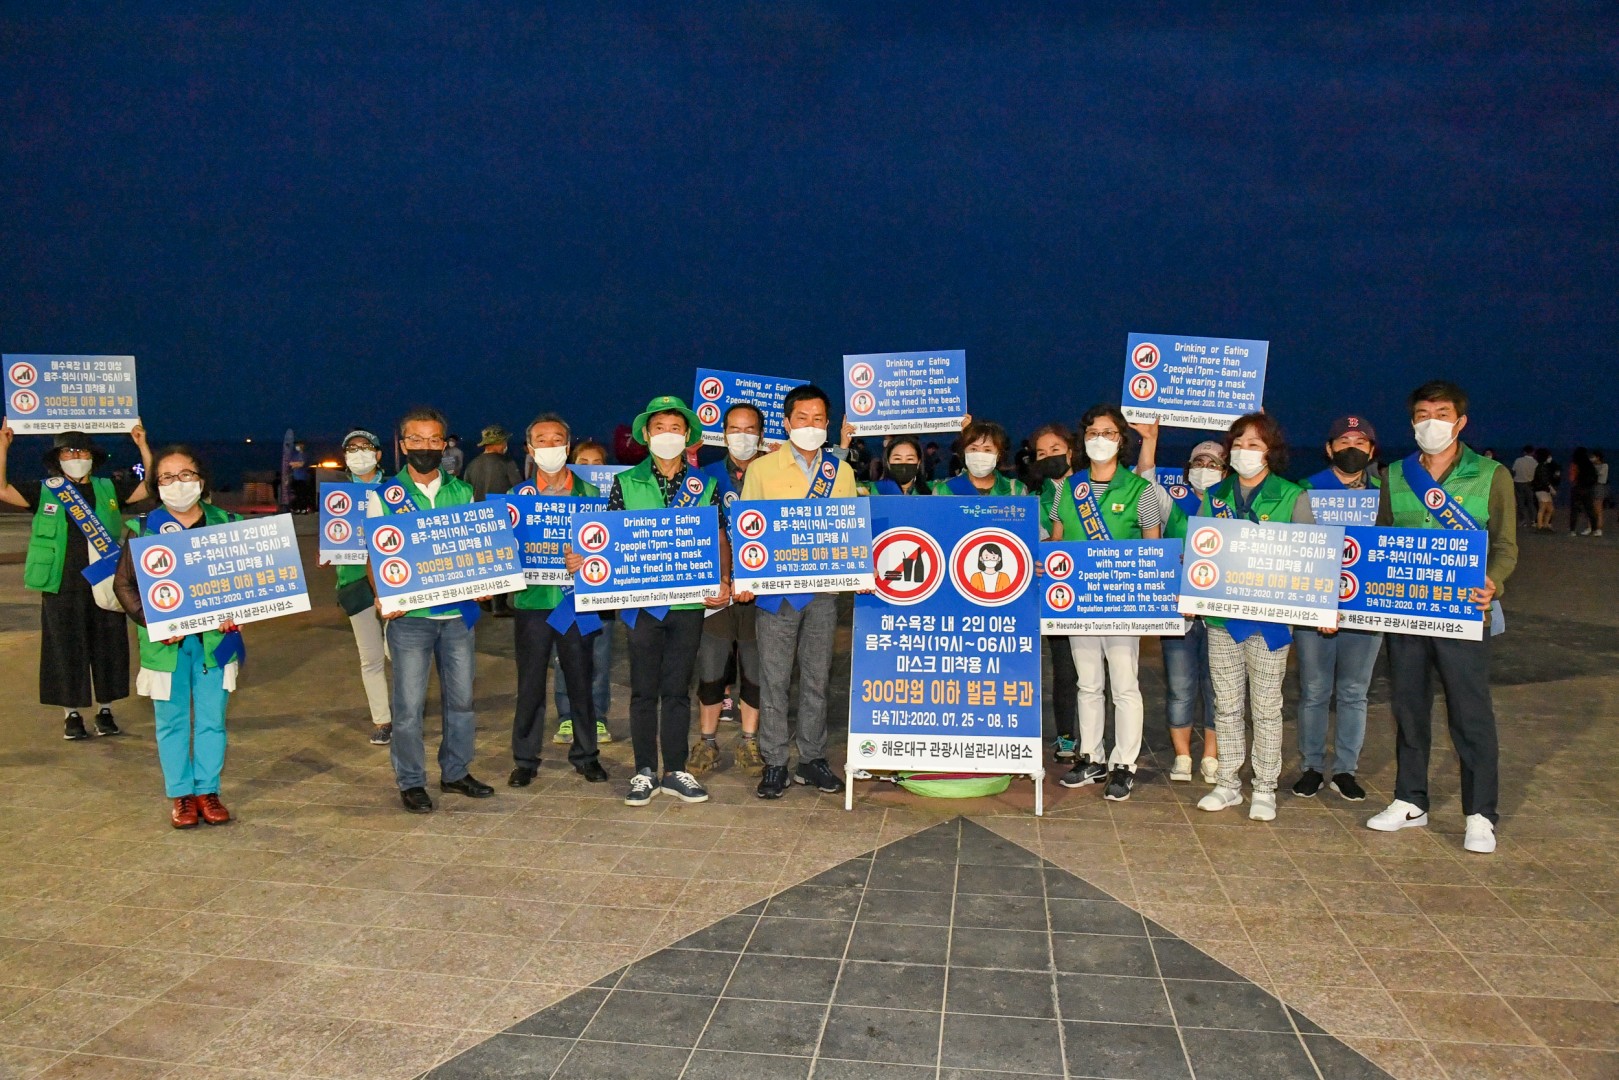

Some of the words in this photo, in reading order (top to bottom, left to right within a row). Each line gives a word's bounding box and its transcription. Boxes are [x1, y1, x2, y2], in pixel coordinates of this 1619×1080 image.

[1174, 342, 1206, 354] Drinking
[1224, 345, 1249, 357] Eating
[50, 361, 80, 370] 해수욕장
[83, 361, 90, 370] 내
[94, 361, 105, 370] 2인
[107, 361, 121, 370] 이상
[886, 358, 913, 368] Drinking
[929, 356, 949, 367] Eating
[61, 384, 82, 393] 마스크
[85, 384, 105, 393] 미착용
[108, 384, 114, 392] 시
[44, 396, 77, 406] 300만원
[80, 396, 95, 406] 이하
[99, 396, 114, 406] 벌금
[117, 396, 132, 406] 부과
[63, 421, 125, 429] 관광시설관리사업소
[780, 505, 811, 517] 해수욕장
[814, 505, 822, 516] 내
[826, 505, 838, 515] 2인
[840, 504, 855, 515] 이상
[1361, 497, 1375, 508] 2인
[416, 514, 449, 529] 해수욕장
[451, 512, 460, 523] 내
[463, 509, 477, 522] 2인
[477, 507, 494, 519] 이상
[623, 516, 656, 528] Drinking
[661, 517, 669, 525] or
[675, 514, 700, 526] Eating
[190, 531, 227, 549] 해수욕장
[229, 529, 240, 542] 내
[242, 526, 258, 540] 2인
[259, 523, 278, 537] 이상
[632, 529, 649, 538] with
[652, 529, 672, 537] more
[675, 526, 692, 535] than
[791, 533, 813, 544] 마스크
[816, 532, 838, 543] 미착용
[841, 532, 848, 542] 시
[1240, 527, 1275, 540] 해수욕장
[1278, 529, 1287, 541] 내
[1291, 530, 1306, 542] 2인
[1308, 531, 1327, 544] 이상
[432, 541, 456, 555] 마스크
[457, 536, 482, 551] 미착용
[483, 535, 491, 546] 시
[1378, 535, 1413, 548] 해수욕장
[1417, 536, 1426, 548] 내
[1431, 537, 1446, 550] 2인
[1449, 538, 1468, 551] 이상
[624, 552, 636, 562] Not
[640, 551, 671, 562] wearing
[681, 549, 702, 558] mask
[773, 548, 808, 562] 300만원
[811, 547, 828, 560] 이하
[831, 546, 848, 559] 벌금
[851, 546, 867, 558] 부과
[1087, 547, 1119, 558] Drinking
[1138, 546, 1163, 557] Eating
[207, 560, 234, 576] 마스크
[236, 555, 263, 571] 미착용
[264, 553, 273, 565] 시
[415, 556, 454, 575] 300만원
[455, 553, 474, 568] 이하
[475, 550, 494, 564] 벌금
[495, 546, 514, 561] 부과
[614, 565, 628, 574] will
[630, 564, 640, 573] be
[643, 563, 662, 572] fined
[665, 562, 672, 571] in
[675, 561, 687, 570] the
[690, 559, 712, 569] beach
[1095, 559, 1112, 567] with
[1138, 558, 1155, 567] than
[1247, 556, 1273, 570] 마스크
[1275, 558, 1302, 572] 미착용
[1304, 561, 1313, 573] 시
[188, 577, 231, 598] 300만원
[233, 573, 253, 589] 이하
[256, 569, 276, 585] 벌금
[277, 565, 297, 581] 부과
[1224, 570, 1264, 586] 300만원
[1267, 574, 1287, 588] 이하
[1290, 576, 1310, 590] 벌금
[1313, 578, 1333, 592] 부과
[1387, 566, 1413, 579] 마스크
[1416, 567, 1443, 581] 미착용
[1446, 569, 1455, 582] 시
[761, 579, 791, 589] 해운대구
[793, 576, 859, 588] 관광시설관리사업소
[1087, 581, 1099, 590] Not
[1103, 582, 1134, 591] wearing
[1144, 581, 1165, 590] mask
[408, 590, 440, 605] 해운대구
[441, 578, 510, 599] 관광시설관리사업소
[591, 594, 628, 605] Haeundae-gu
[630, 593, 649, 601] Tourism
[650, 592, 668, 601] Facility
[669, 589, 701, 600] Management
[701, 588, 715, 596] Office
[1364, 581, 1405, 597] 300만원
[1408, 584, 1428, 599] 이하
[1432, 586, 1452, 601] 벌금
[1206, 601, 1239, 613] 해운대구
[1241, 605, 1318, 621] 관광시설관리사업소
[179, 614, 215, 630] 해운대구
[881, 615, 935, 631] 해수욕장
[941, 616, 954, 631] 내
[962, 616, 984, 632] 2인
[989, 616, 1016, 632] 이상
[1056, 621, 1091, 630] Haeundae-gu
[1112, 622, 1130, 631] Facility
[1131, 621, 1163, 631] Management
[1164, 621, 1179, 629] Office
[1348, 613, 1381, 625] 해운대구
[1383, 617, 1463, 633] 관광시설관리사업소
[897, 656, 936, 672] 마스크
[942, 657, 981, 673] 미착용
[986, 658, 999, 673] 시
[862, 679, 923, 704] 300만원
[931, 679, 960, 704] 이하
[967, 680, 996, 705] 벌금
[1003, 681, 1033, 706] 부과
[882, 741, 926, 757] 해운대구
[930, 742, 1032, 759] 관광시설관리사업소
